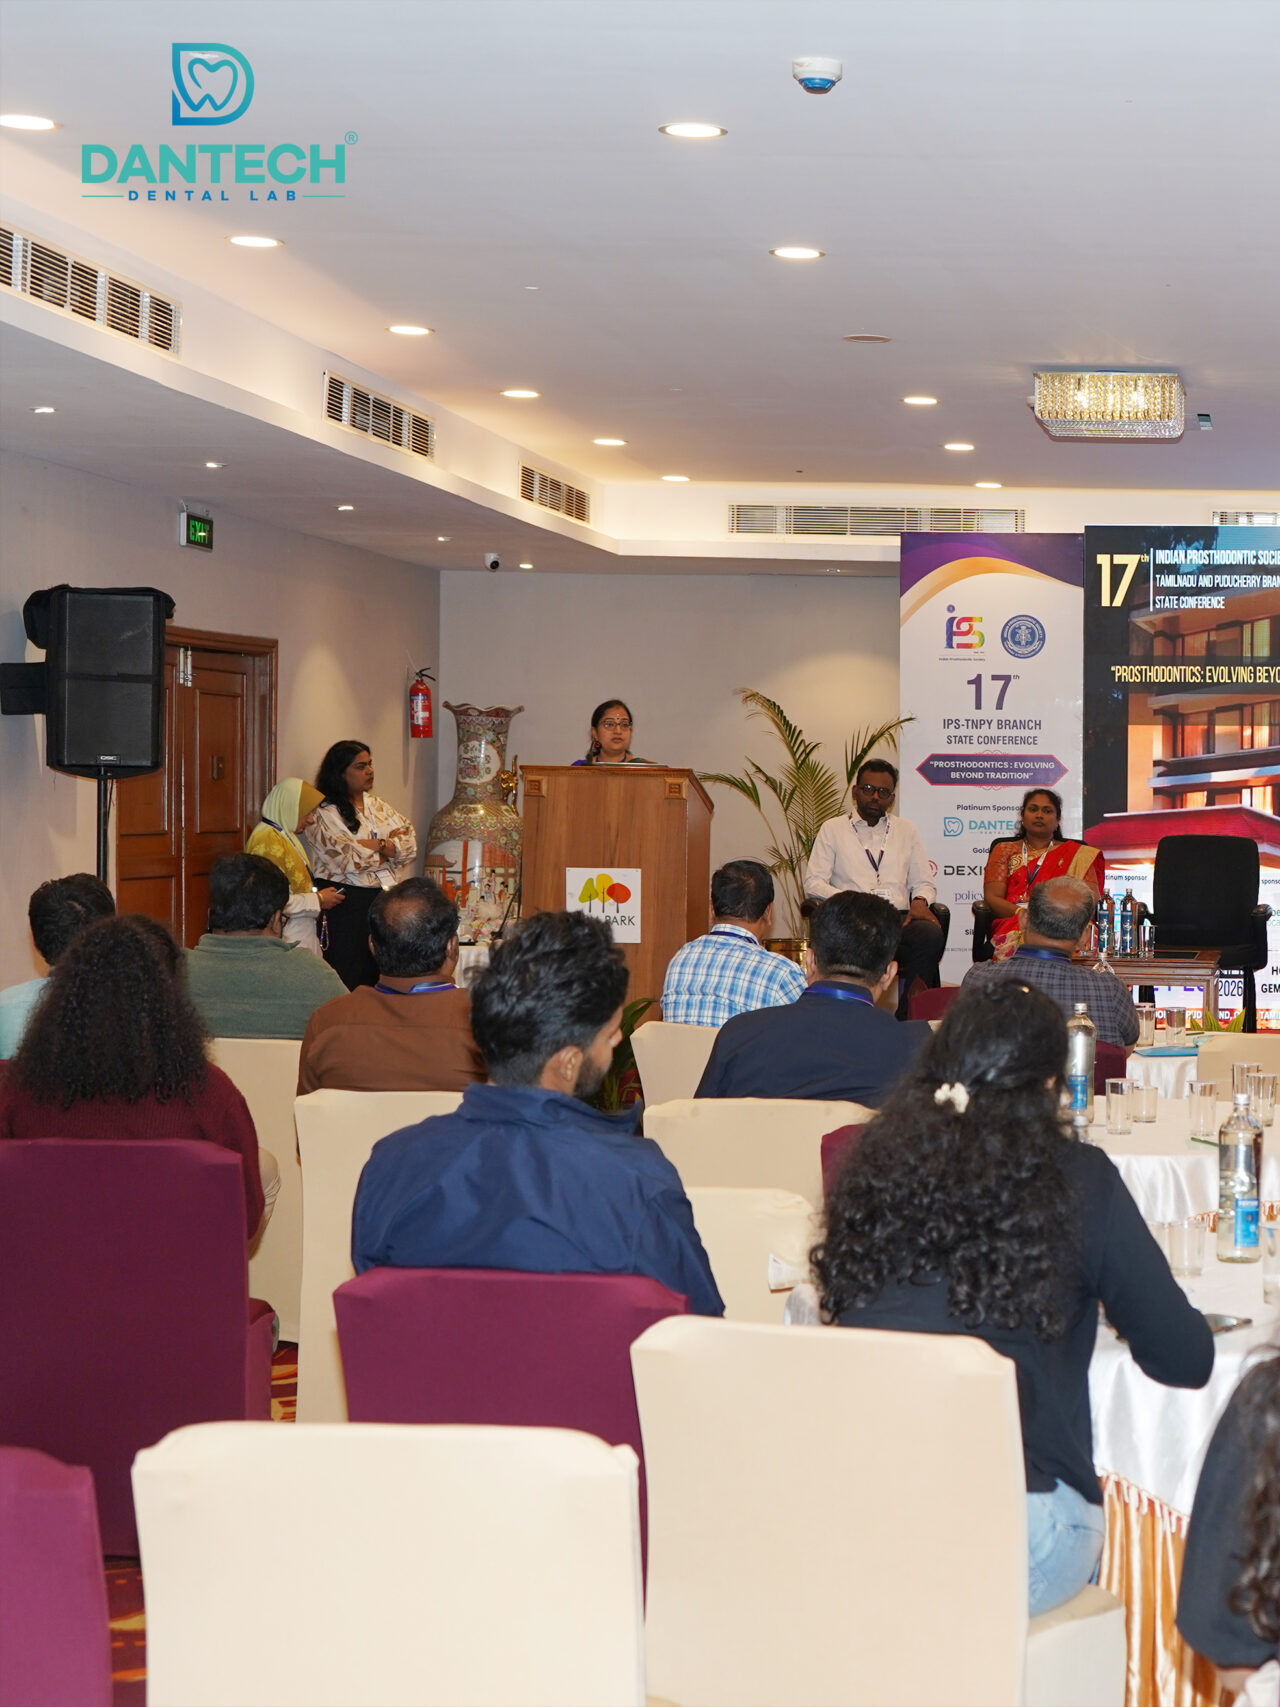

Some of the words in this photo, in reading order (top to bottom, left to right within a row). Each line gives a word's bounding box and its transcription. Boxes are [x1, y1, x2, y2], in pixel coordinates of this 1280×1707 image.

[190, 519, 210, 545] EXIT
[1155, 549, 1186, 564] INDIAN
[1187, 549, 1256, 565] PROSTHODONTIC
[1155, 574, 1197, 587] TAMILNADU
[1198, 574, 1213, 587] AND
[1214, 575, 1261, 588] PUDUCHERRY
[1155, 595, 1178, 609] STATE
[1179, 596, 1225, 609] CONFERENCE
[1206, 666, 1254, 683] EVOLVING
[943, 718, 993, 730] IPS-TNPY
[997, 719, 1042, 730] BRANCH
[946, 734, 974, 745] STATE
[977, 735, 1038, 746] CONFERENCE
[951, 771, 984, 779] BEYOND
[1218, 980, 1243, 997] 2026
